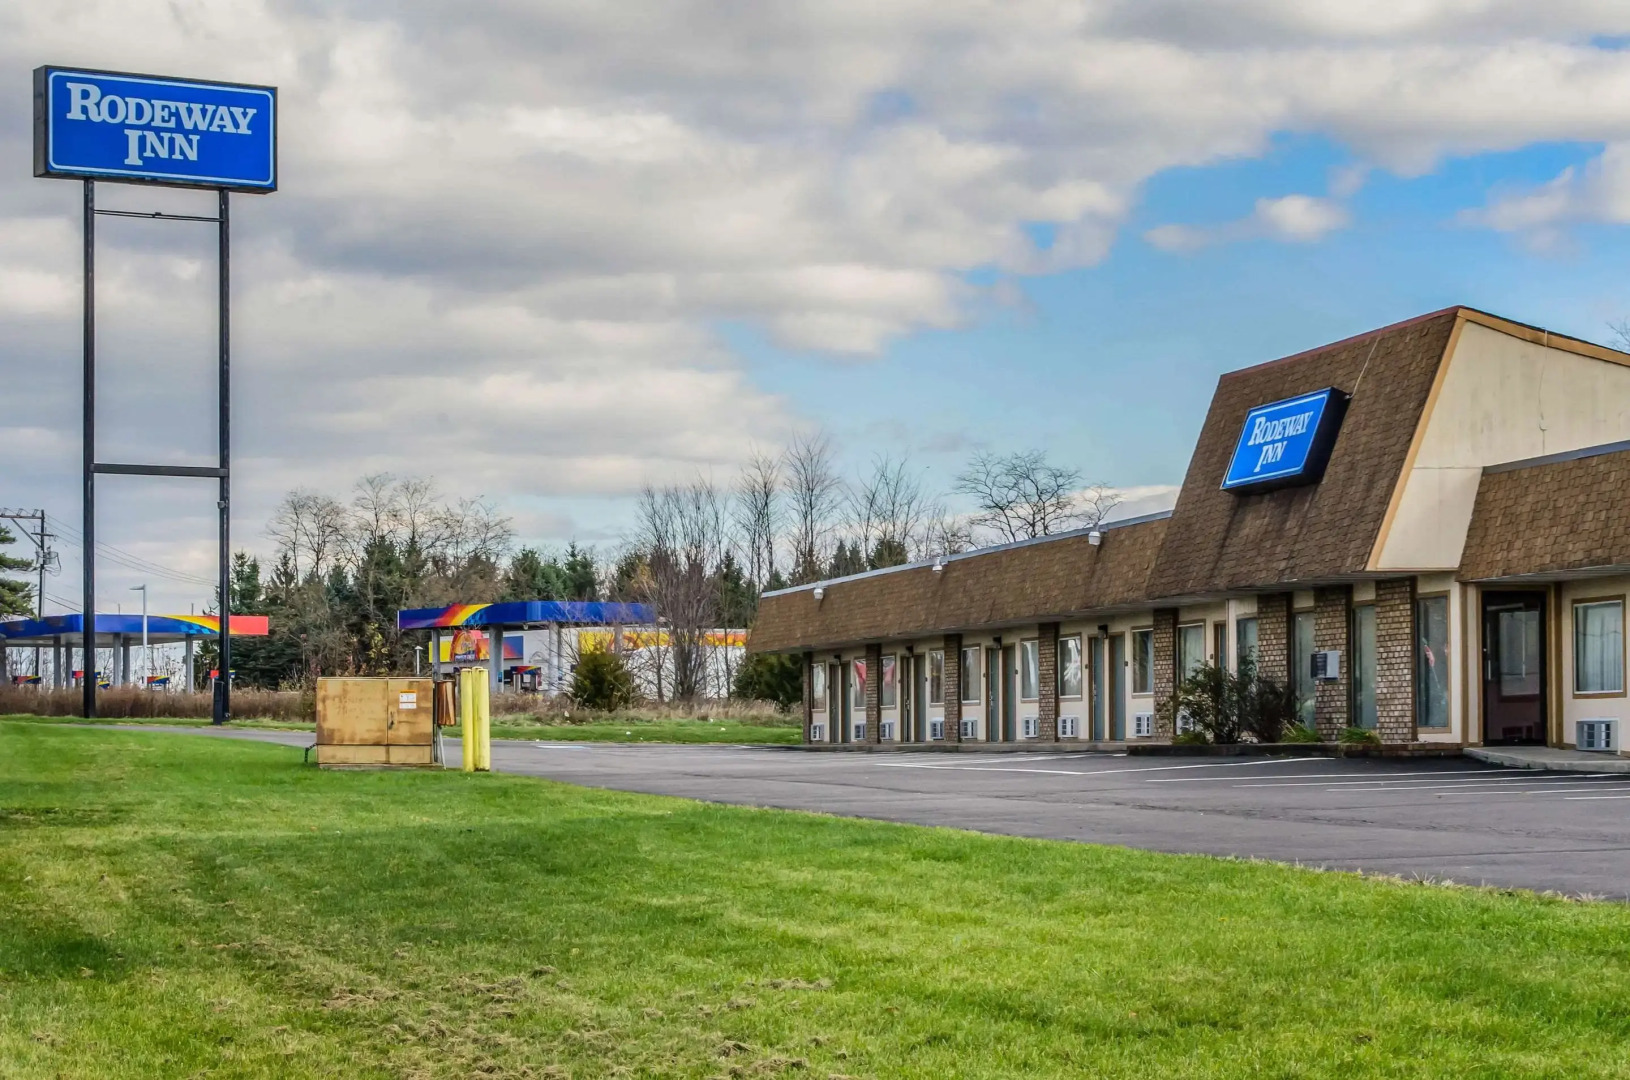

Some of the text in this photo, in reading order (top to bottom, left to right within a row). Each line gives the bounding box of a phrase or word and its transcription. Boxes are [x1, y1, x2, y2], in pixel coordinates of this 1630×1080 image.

[66, 82, 257, 135] RODEWAY
[124, 128, 200, 166] INN
[1247, 411, 1314, 446] RODEWAY
[1253, 441, 1288, 473] INN
